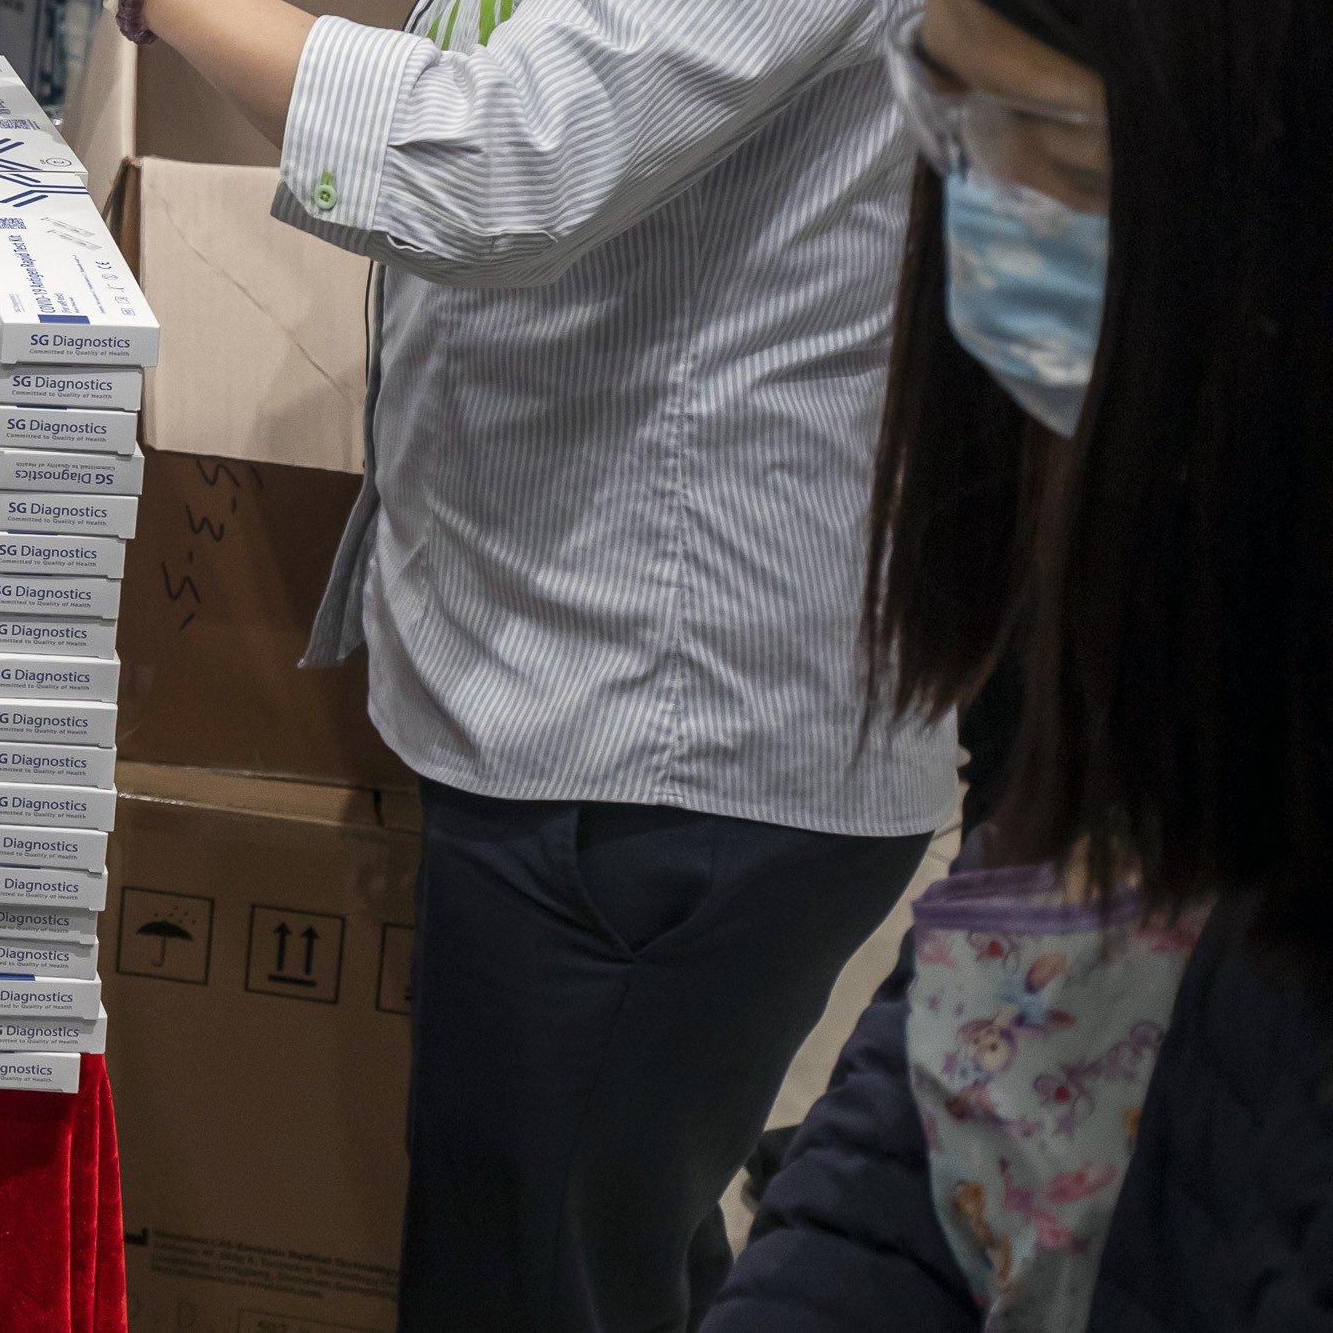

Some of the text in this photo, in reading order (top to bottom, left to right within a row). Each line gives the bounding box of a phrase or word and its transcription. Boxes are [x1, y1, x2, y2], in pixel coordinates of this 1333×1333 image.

[12, 243, 28, 252] Test
[15, 253, 37, 267] Rapid
[27, 268, 45, 288] Antigen
[32, 289, 56, 313] COVID-19
[30, 334, 130, 350] SG Diagnostics
[12, 375, 113, 392] SG Diagnostics
[7, 418, 107, 435] SG Diagnostics
[15, 468, 114, 485] SG Diagnostics
[8, 502, 107, 518] SG Diagnostics
[0, 544, 97, 560] SG Diagnostics
[15, 586, 91, 601] Diagnostics
[3, 836, 78, 852] Diagnostics
[0, 990, 73, 1004] Diagnostics
